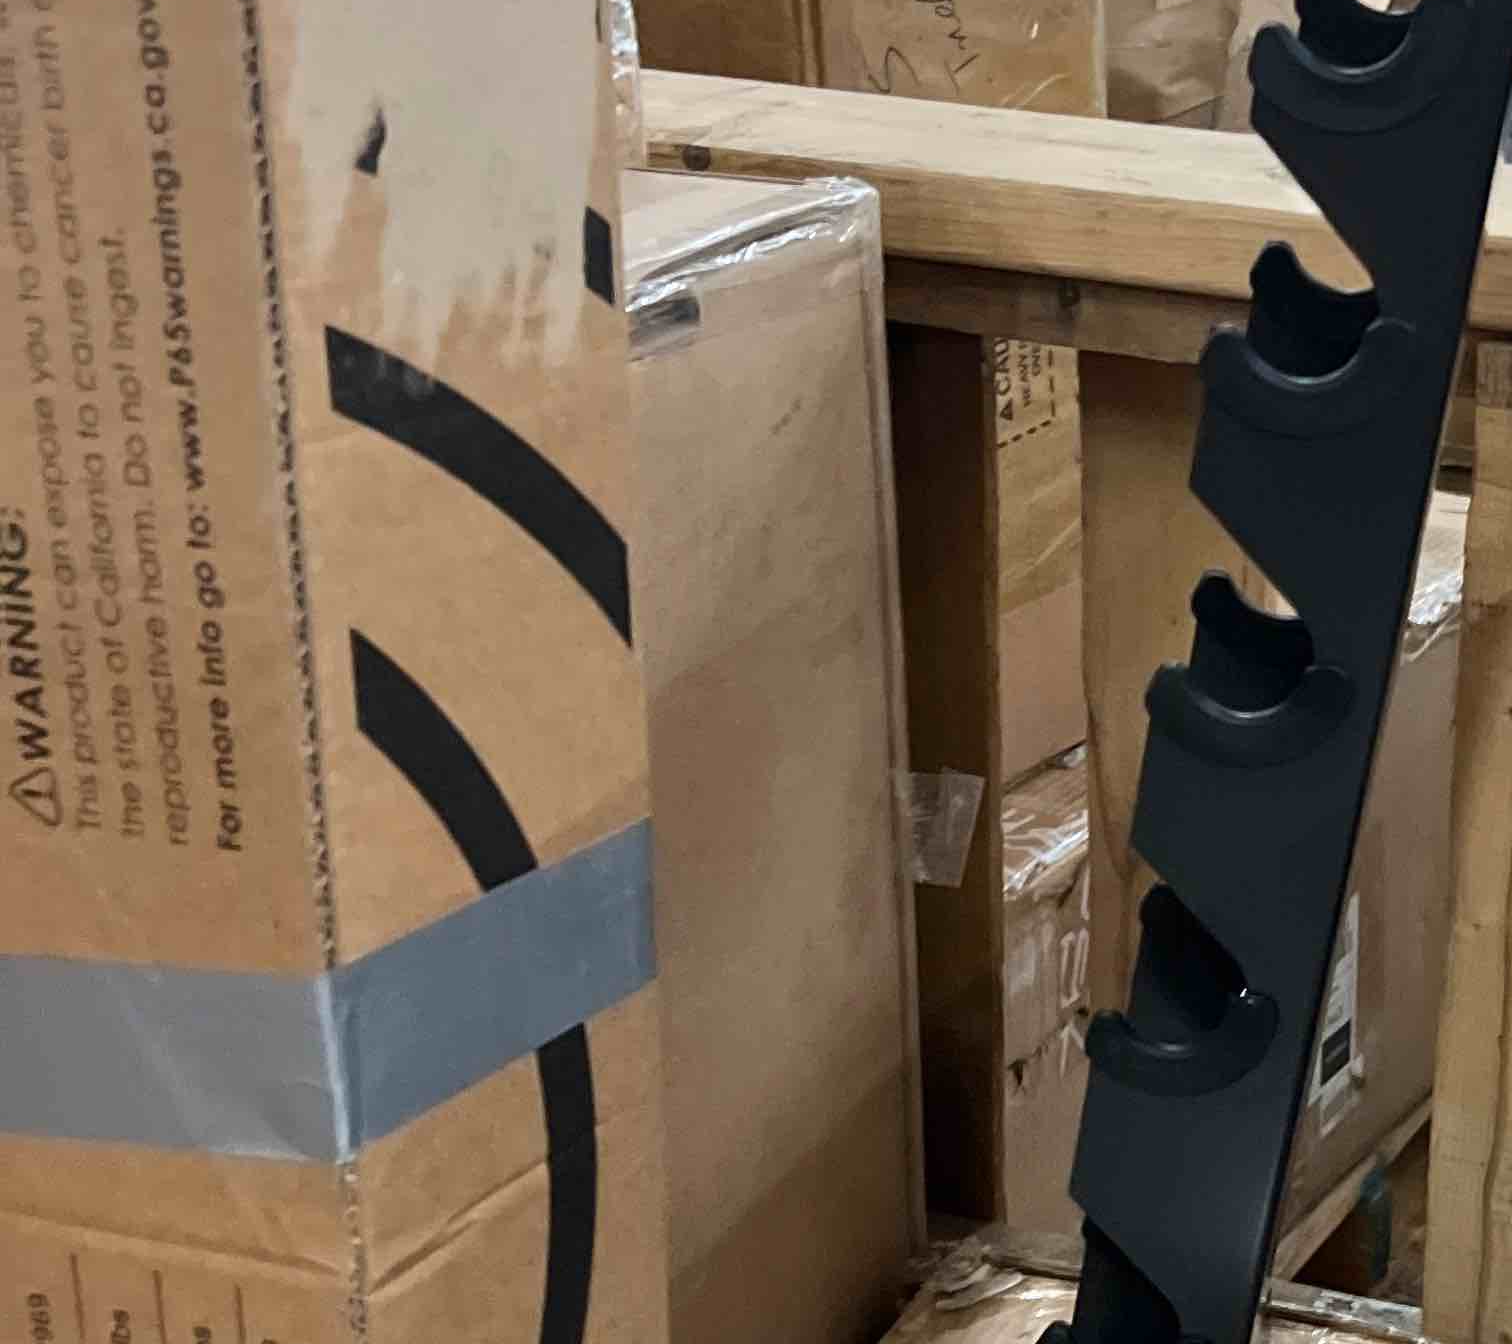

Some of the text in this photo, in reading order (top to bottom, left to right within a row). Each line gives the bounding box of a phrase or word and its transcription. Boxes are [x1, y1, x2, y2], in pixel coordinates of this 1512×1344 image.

[13, 264, 41, 302] to
[22, 316, 55, 385] you
[63, 276, 97, 392] cause
[73, 401, 101, 440] to
[111, 360, 145, 423] not
[30, 395, 72, 528] expose
[118, 433, 152, 488] Do
[77, 451, 123, 627] California
[181, 504, 212, 550] to:
[48, 537, 77, 608] can
[191, 559, 225, 610] go
[99, 637, 128, 675] of
[193, 619, 226, 688] info
[57, 620, 97, 765] product
[104, 684, 138, 772] state
[142, 615, 194, 846] reproductive
[204, 695, 237, 789] more
[113, 780, 145, 839] the
[211, 800, 244, 853] For
